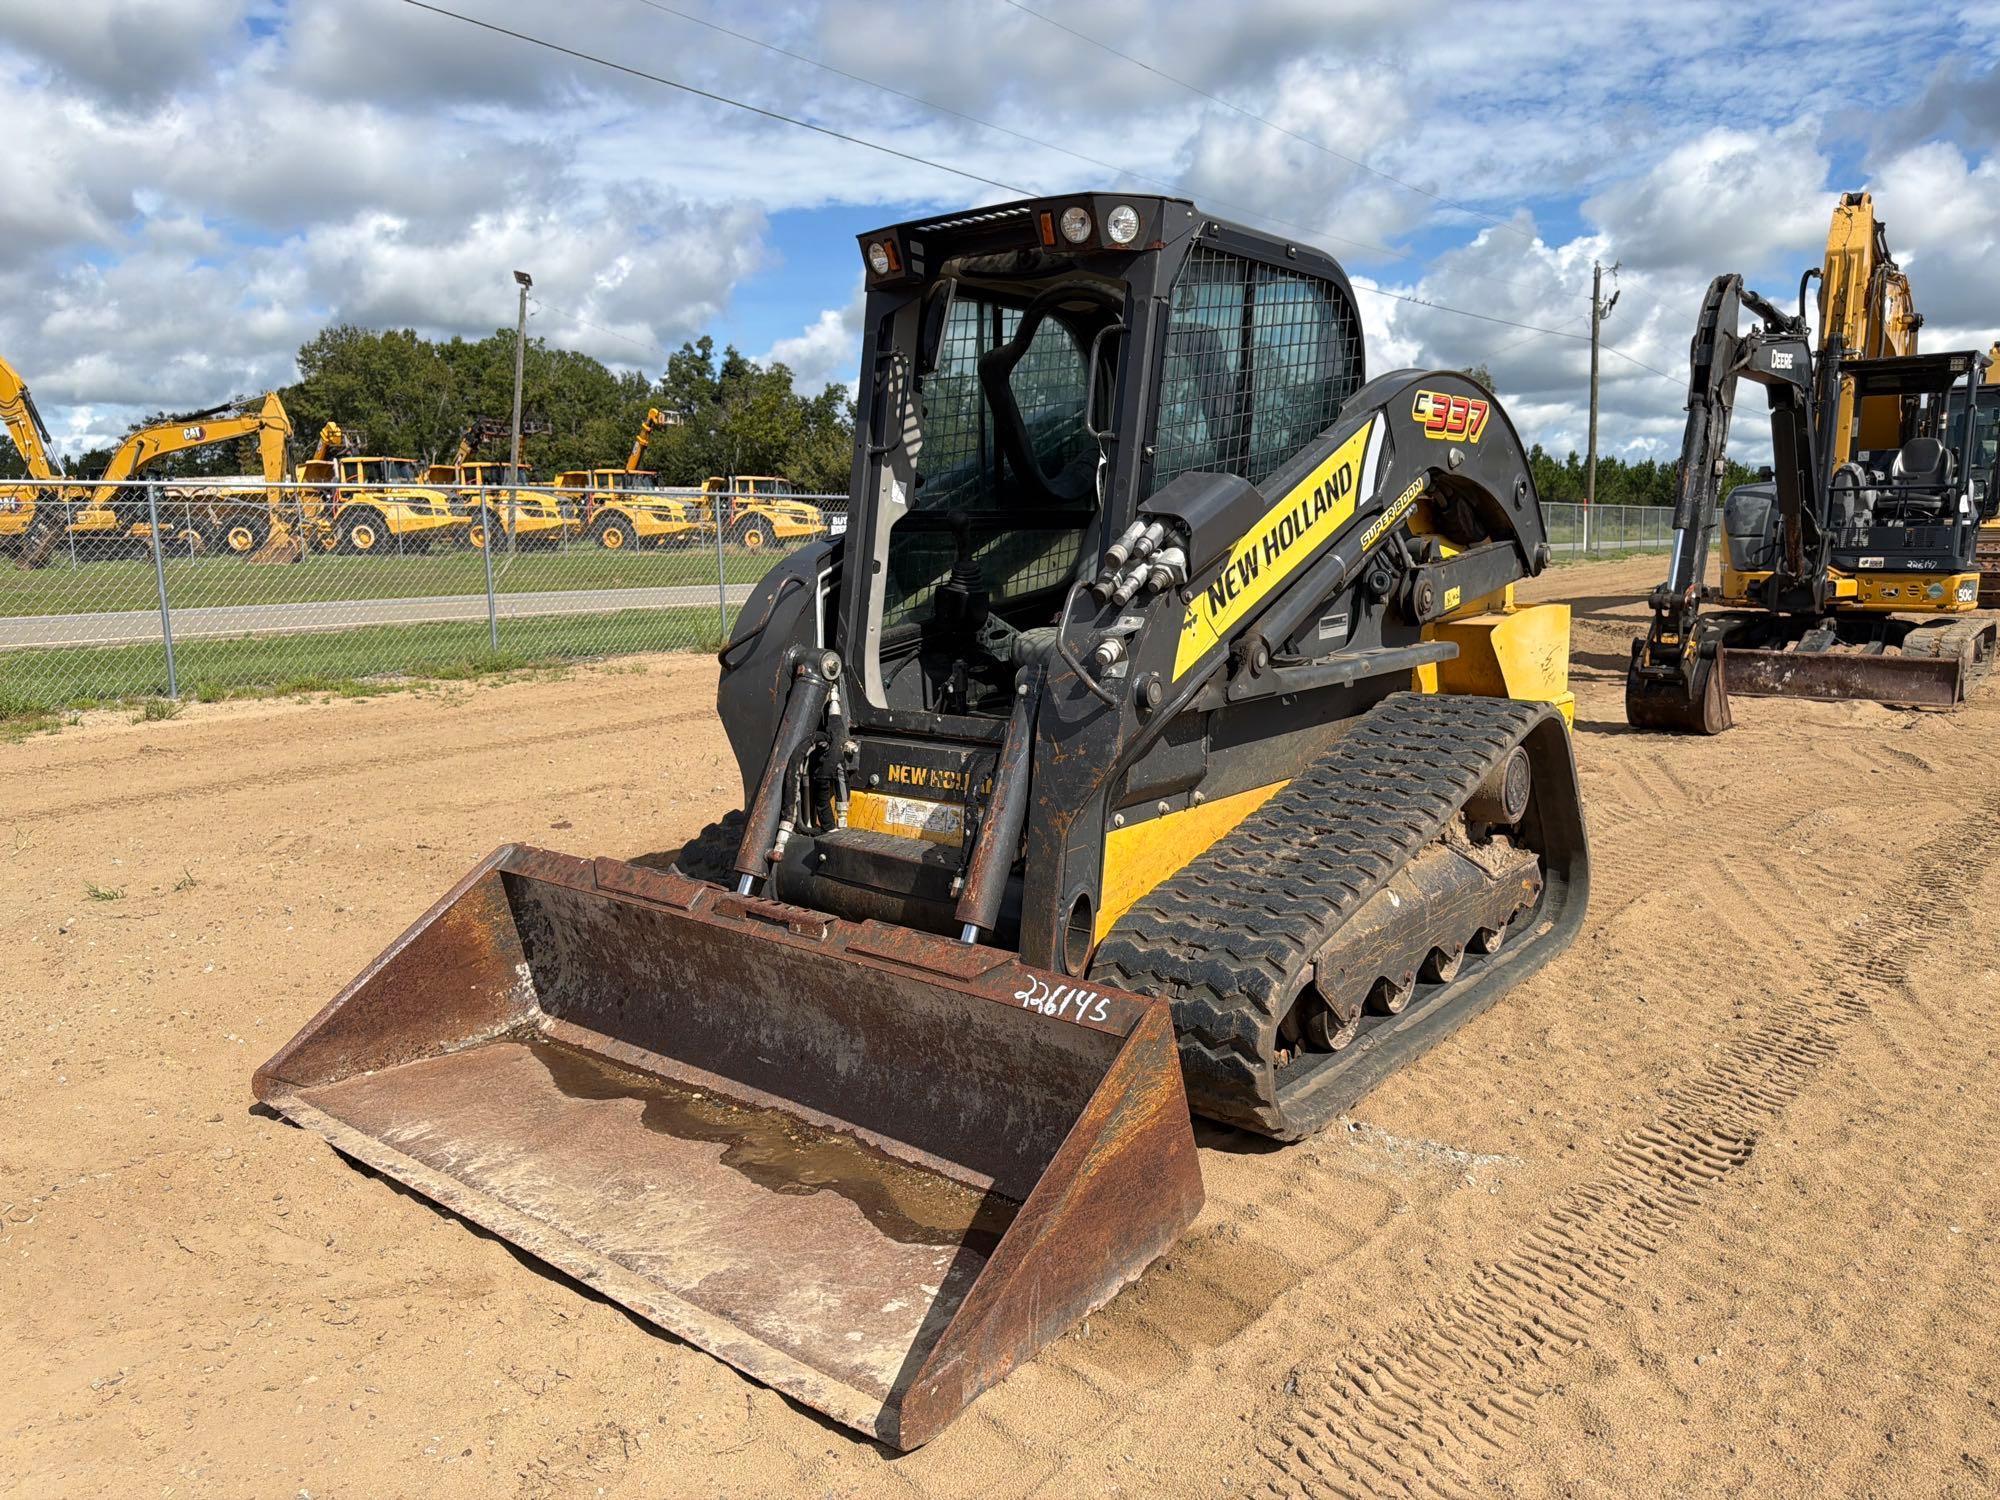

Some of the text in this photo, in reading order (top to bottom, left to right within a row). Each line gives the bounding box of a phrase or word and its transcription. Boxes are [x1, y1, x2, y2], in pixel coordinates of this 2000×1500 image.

[1771, 349, 1793, 369] DEERE
[183, 427, 200, 440] CAT
[1412, 390, 1489, 442] C337
[1361, 477, 1424, 551] SUPER BOOM
[1206, 461, 1352, 617] NEW HOLLAND
[888, 764, 927, 786] NEW
[1014, 974, 1110, 1023] 226145
